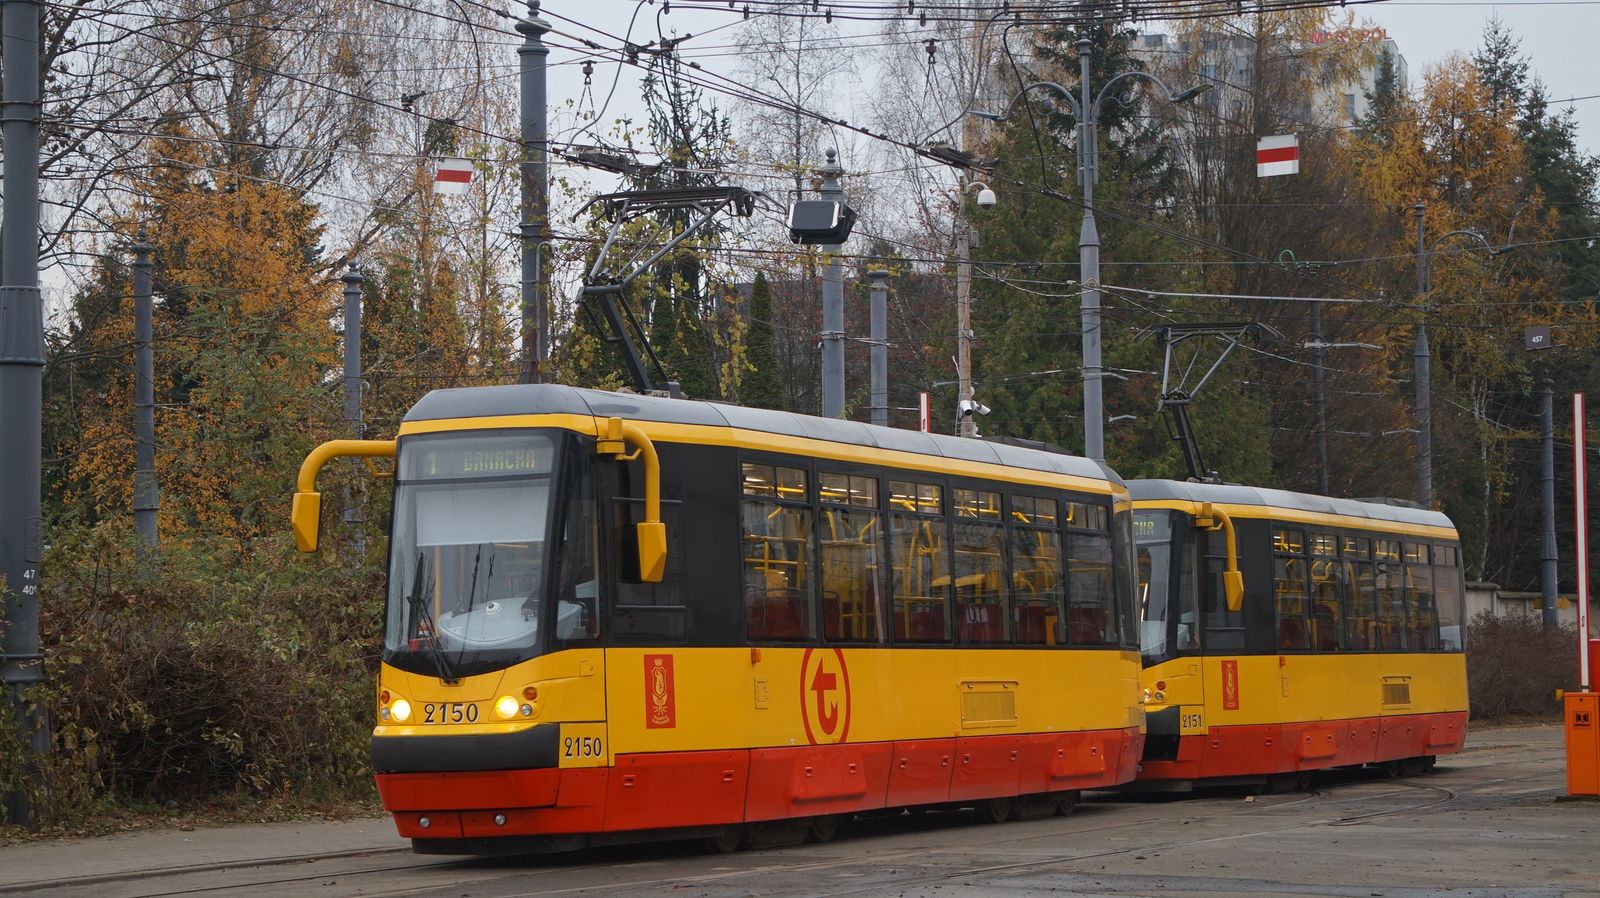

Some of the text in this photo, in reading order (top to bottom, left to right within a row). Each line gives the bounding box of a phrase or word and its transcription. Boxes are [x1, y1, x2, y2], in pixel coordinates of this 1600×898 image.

[1531, 335, 1543, 343] 457
[23, 569, 36, 580] 47
[424, 703, 479, 725] 2150
[1182, 714, 1202, 729] 2151
[564, 736, 603, 758] 2150
